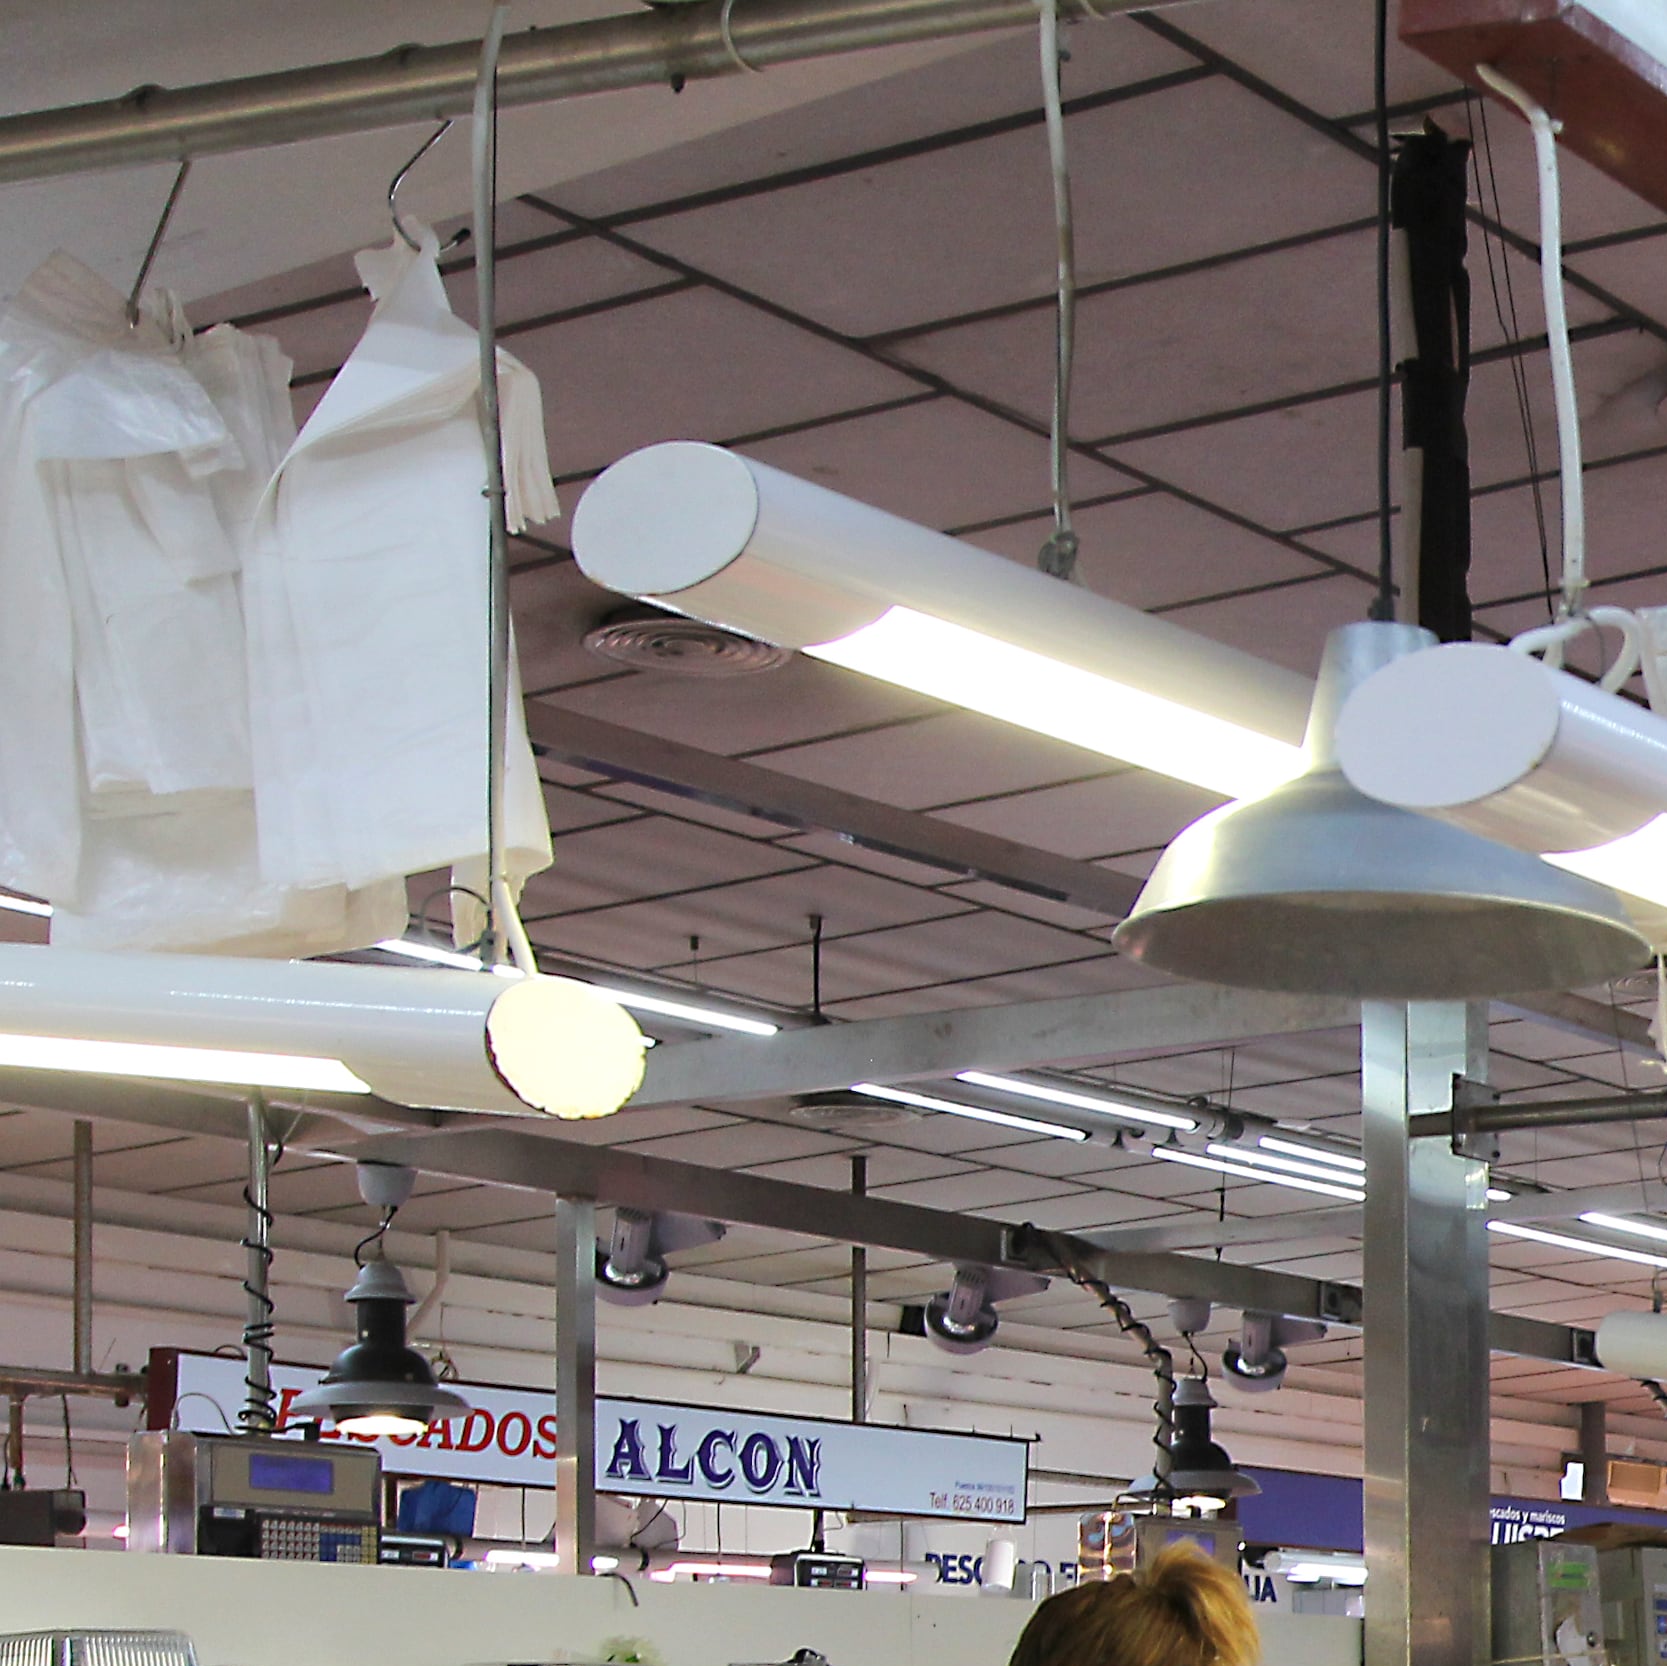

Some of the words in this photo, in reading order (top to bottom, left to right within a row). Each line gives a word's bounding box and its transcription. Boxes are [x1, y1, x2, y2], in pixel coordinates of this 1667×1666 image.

[605, 1418, 823, 1498] ALCON
[952, 1494, 973, 1512] 625
[974, 1496, 994, 1514] 400
[995, 1498, 1015, 1516] 918
[1489, 1505, 1521, 1521] scados
